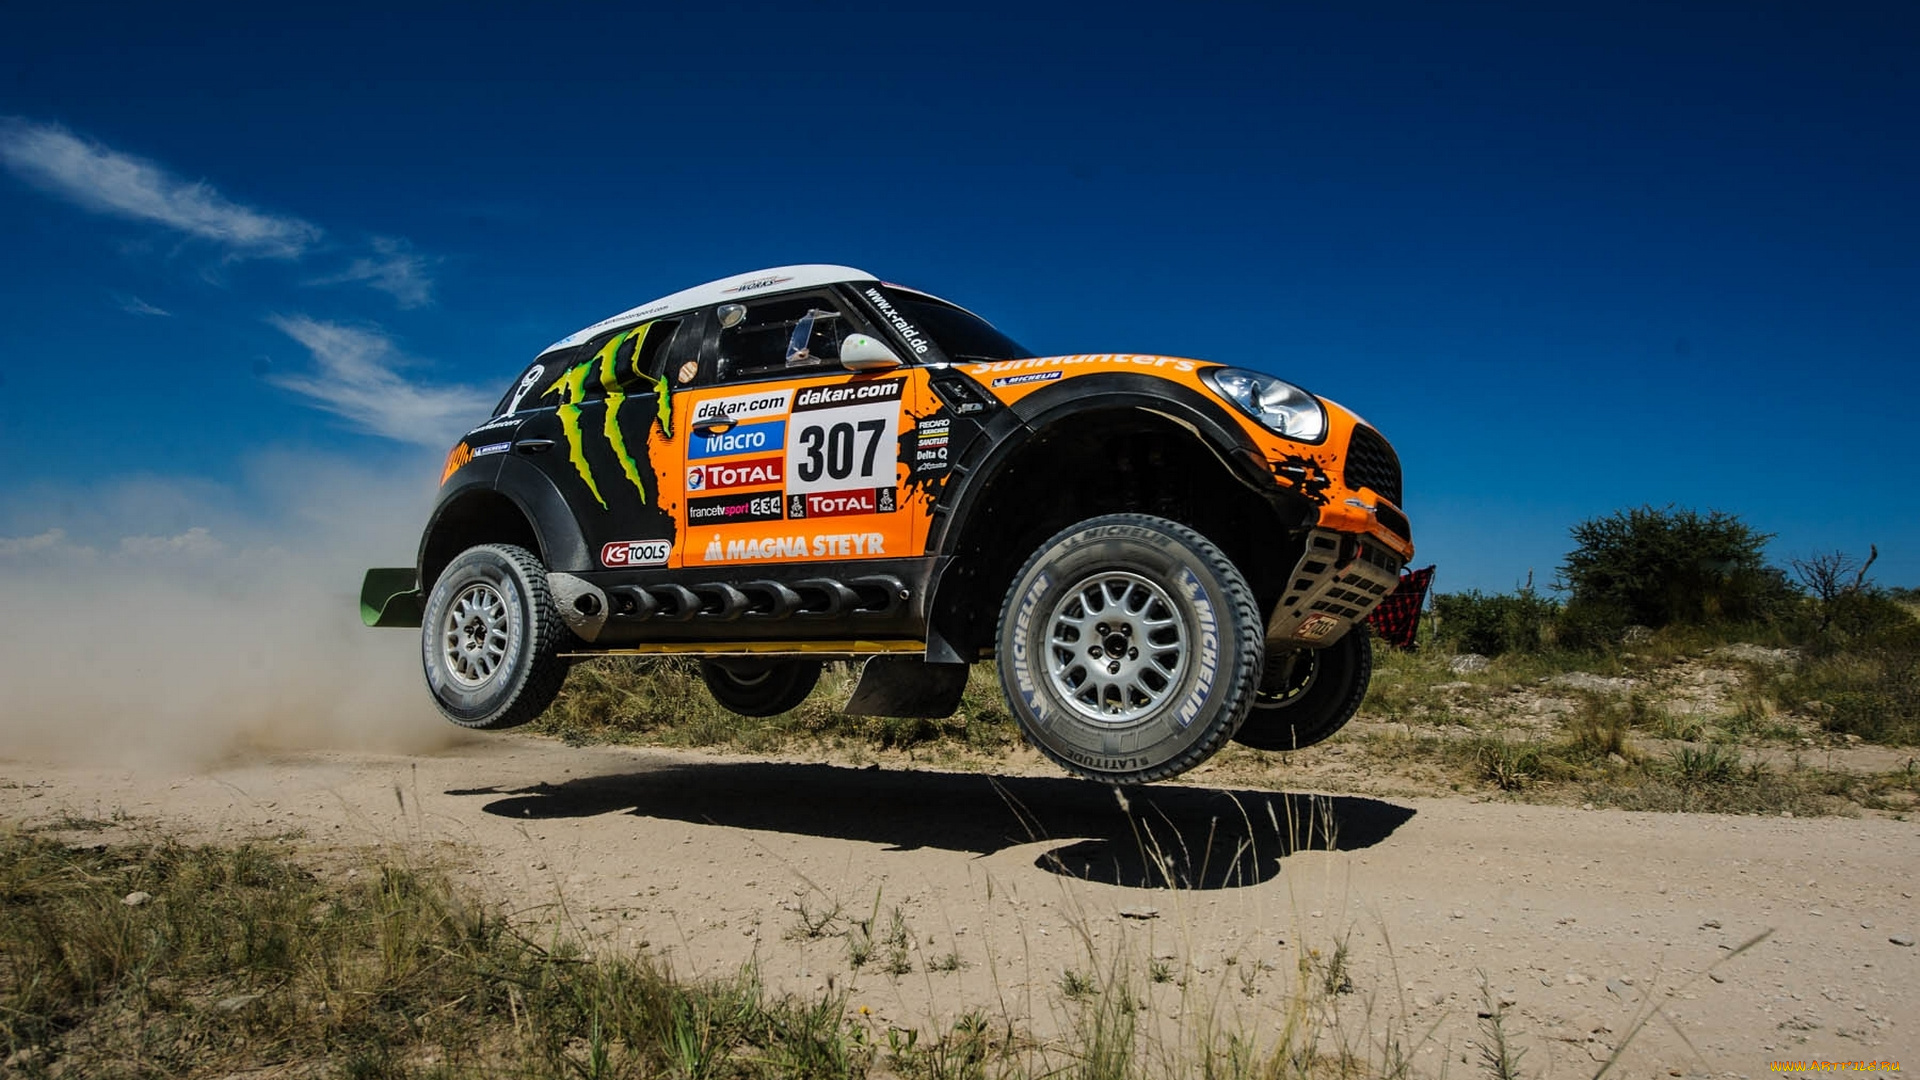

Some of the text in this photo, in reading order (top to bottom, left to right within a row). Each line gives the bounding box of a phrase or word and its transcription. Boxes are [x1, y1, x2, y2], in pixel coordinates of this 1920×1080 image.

[865, 288, 928, 353] www.x-raid.de
[1008, 372, 1060, 384] MICHELIN
[798, 383, 898, 406] dakar.com
[698, 396, 784, 418] dakar.com
[919, 419, 950, 429] RECARO
[706, 431, 766, 453] Macro
[798, 419, 886, 482] 307
[917, 447, 948, 460] Delta Q
[708, 466, 781, 485] TOTAL
[809, 496, 874, 513] TOTAL
[629, 545, 665, 560] TOOLS
[727, 533, 885, 559] MAGNA STEYR
[1014, 574, 1051, 692] MICHELIN
[1180, 599, 1217, 725] MICHELIN
[1066, 749, 1137, 770] LATITUDE
